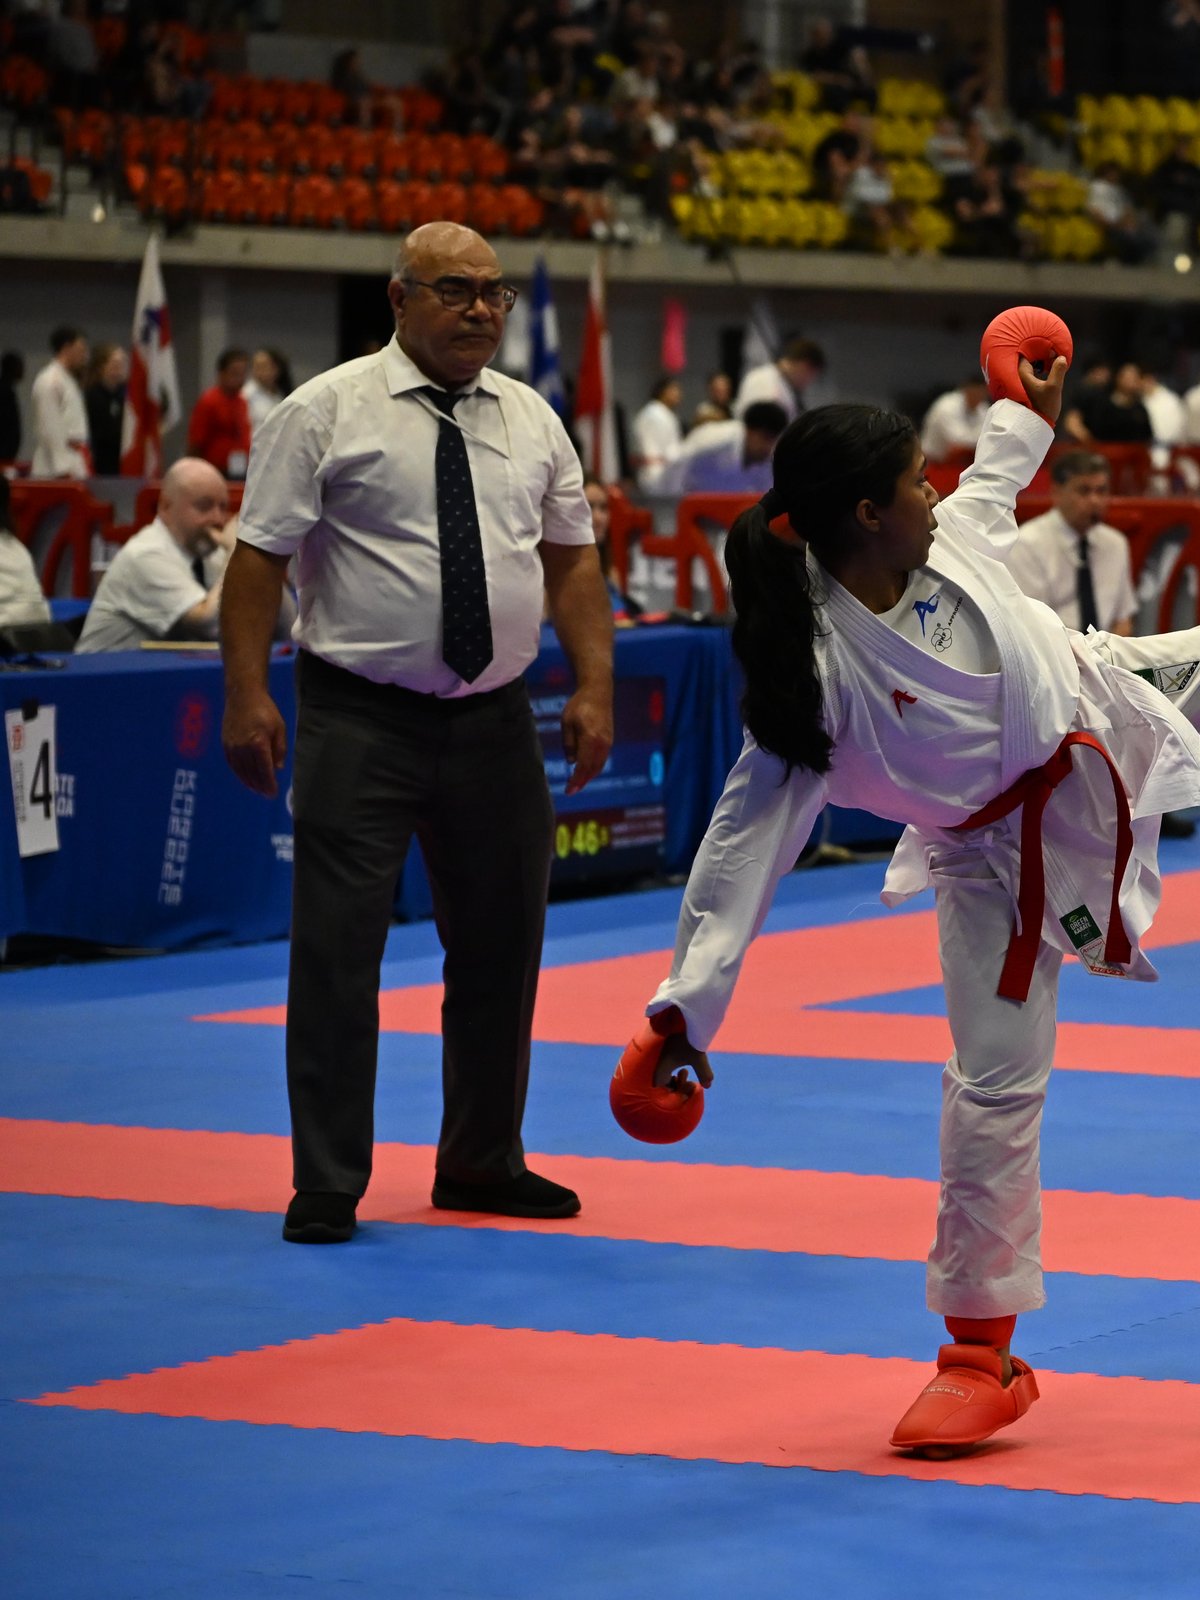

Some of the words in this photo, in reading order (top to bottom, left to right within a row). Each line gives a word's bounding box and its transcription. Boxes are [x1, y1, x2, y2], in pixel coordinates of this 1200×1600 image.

[30, 740, 52, 819] 4
[1070, 916, 1089, 930] GREEN
[1074, 923, 1092, 935] KARATE
